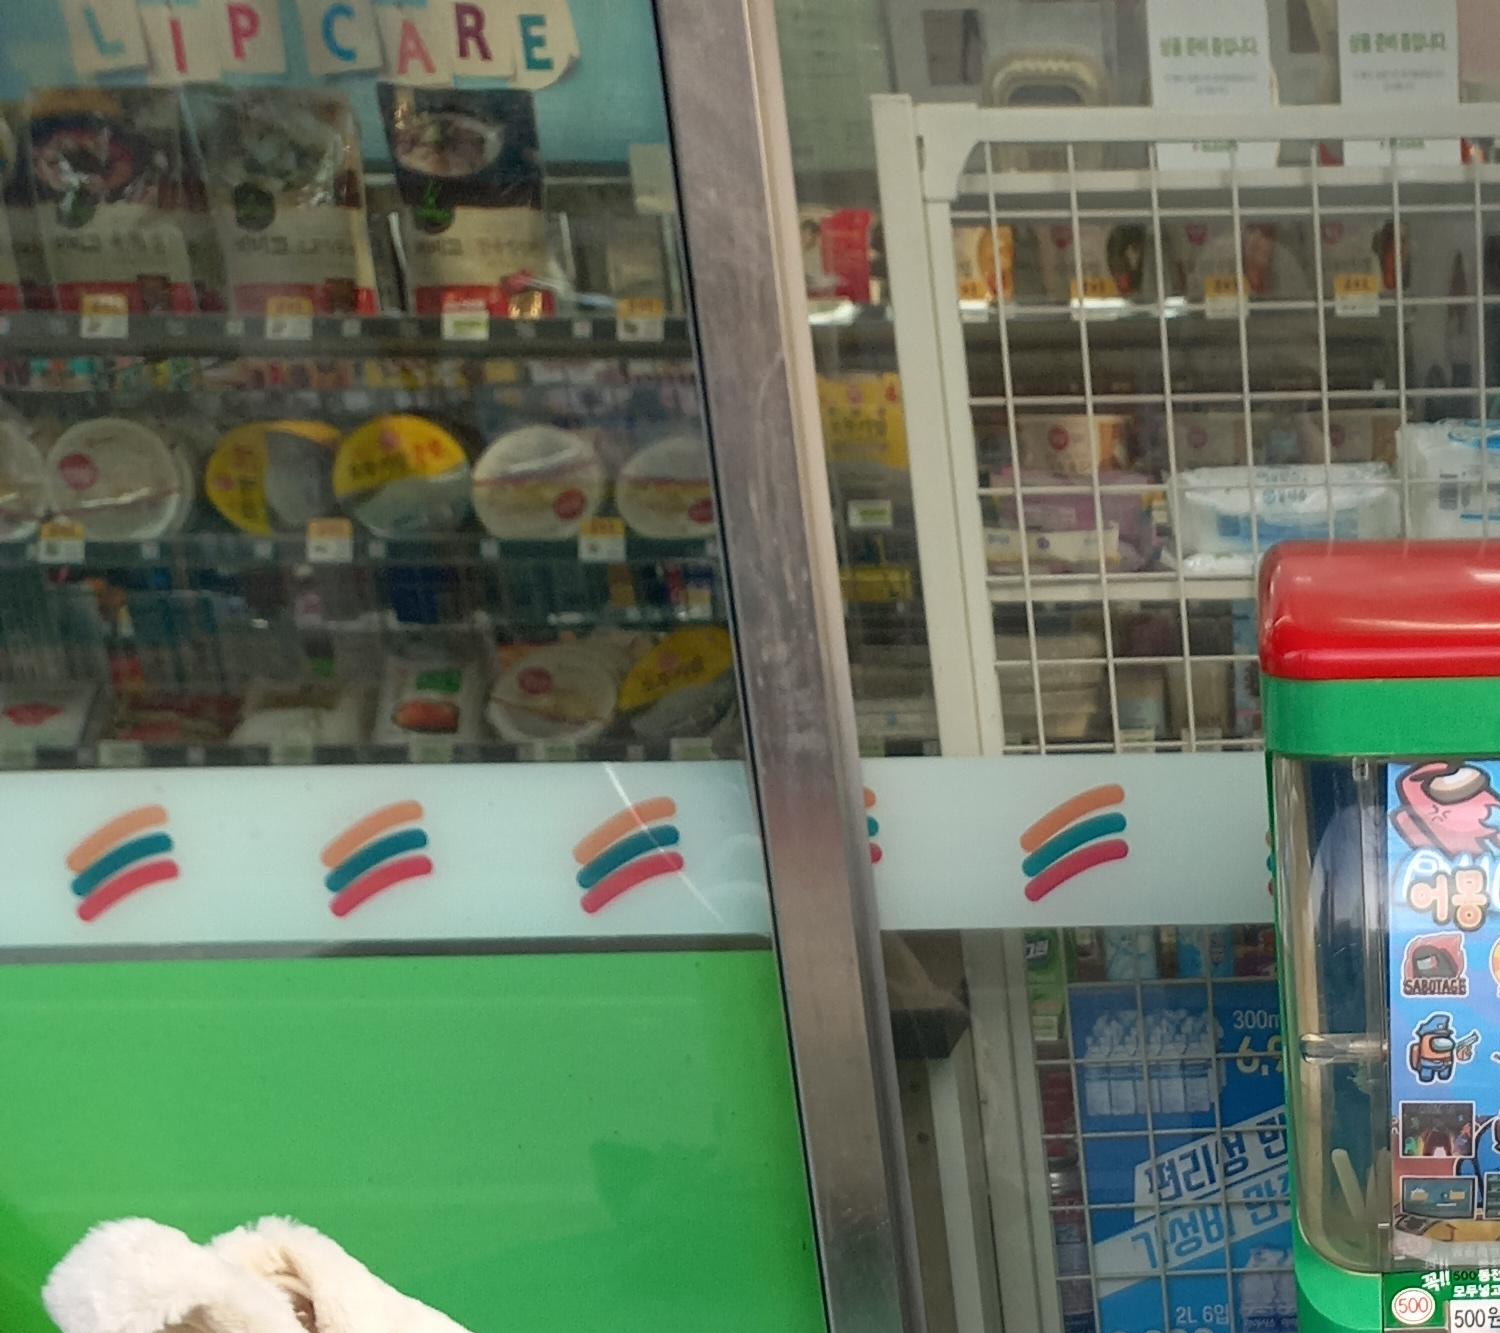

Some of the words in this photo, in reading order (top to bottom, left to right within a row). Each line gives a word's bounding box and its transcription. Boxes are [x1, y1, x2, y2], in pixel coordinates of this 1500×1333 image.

[88, 3, 261, 74] LIP
[321, 2, 554, 74] CARE
[1408, 866, 1489, 930] 어몽
[1403, 978, 1467, 995] SABOTAGE
[1175, 1305, 1198, 1326] 2L
[1398, 1297, 1429, 1315] 500
